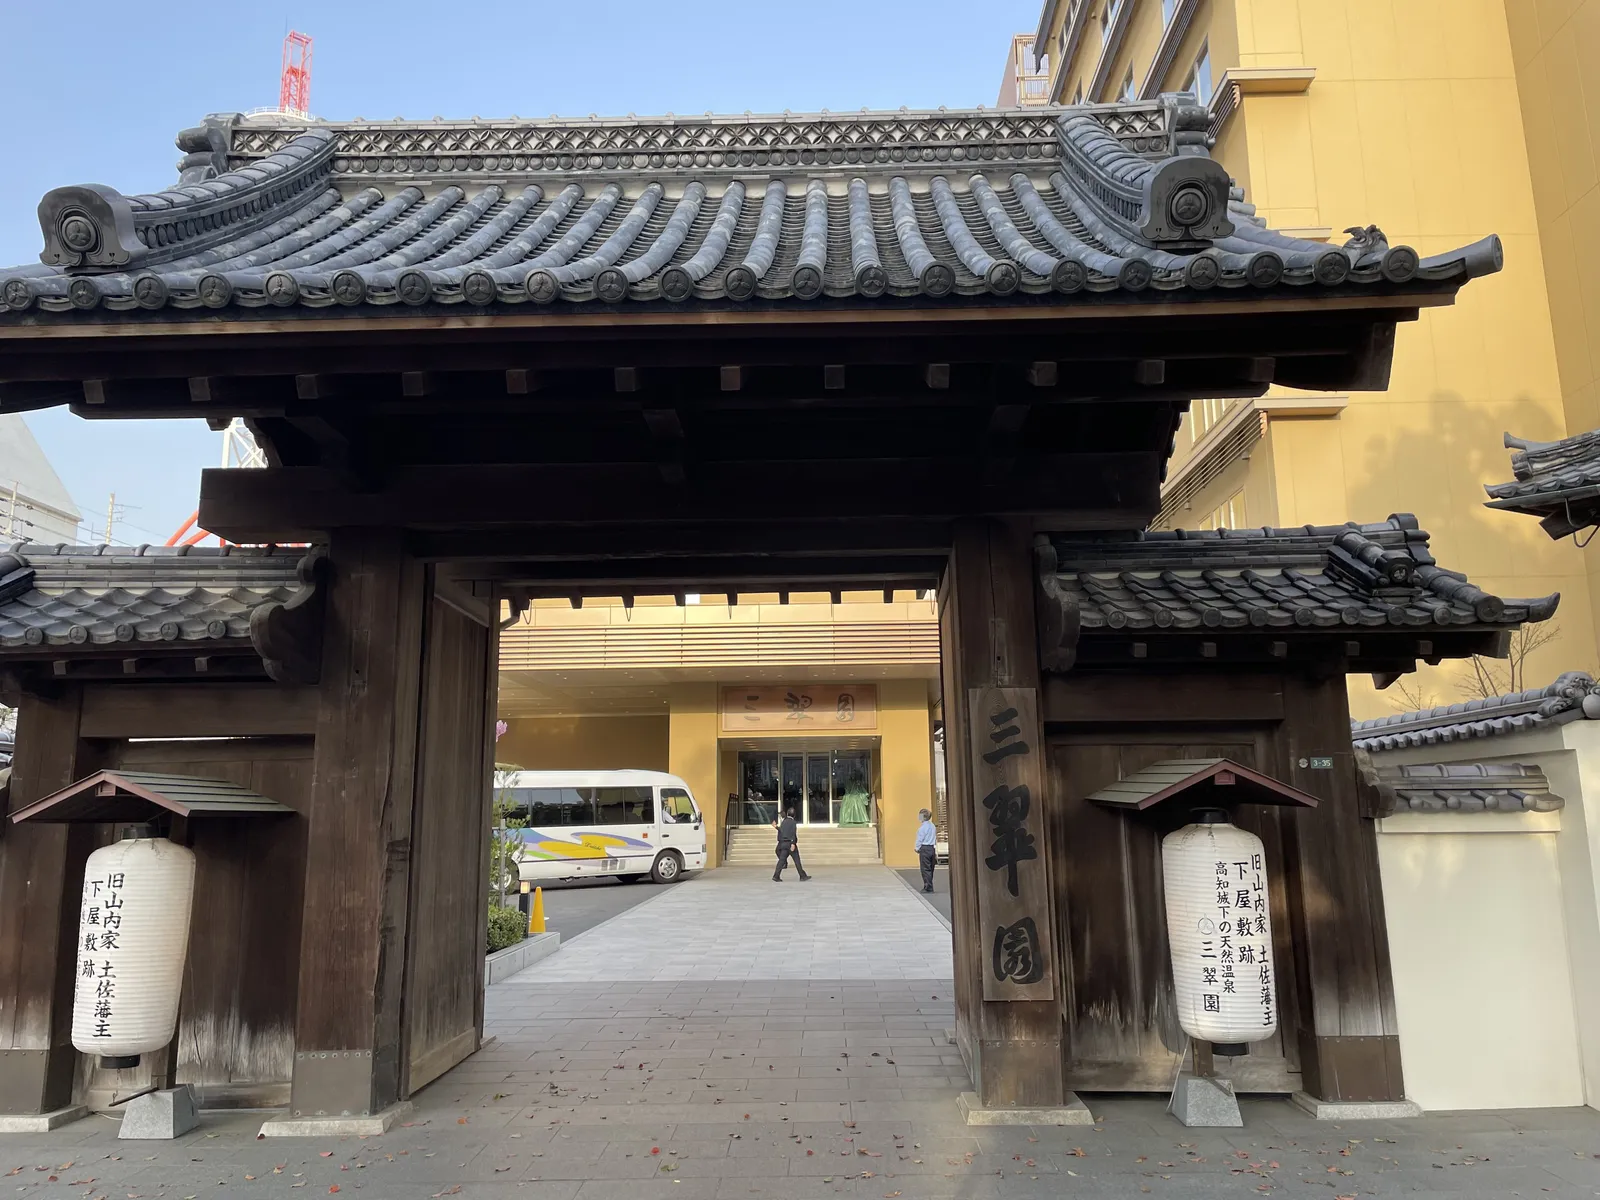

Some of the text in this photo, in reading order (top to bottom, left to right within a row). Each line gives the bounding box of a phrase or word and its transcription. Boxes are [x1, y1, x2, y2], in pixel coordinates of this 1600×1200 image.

[983, 708, 1043, 984] 三翠園
[82, 880, 104, 978] 下屋敷跡
[1215, 861, 1236, 994] 高知城下の天然温泉
[1233, 862, 1256, 965] 下屋敷跡
[1201, 941, 1220, 1013] 三翠園
